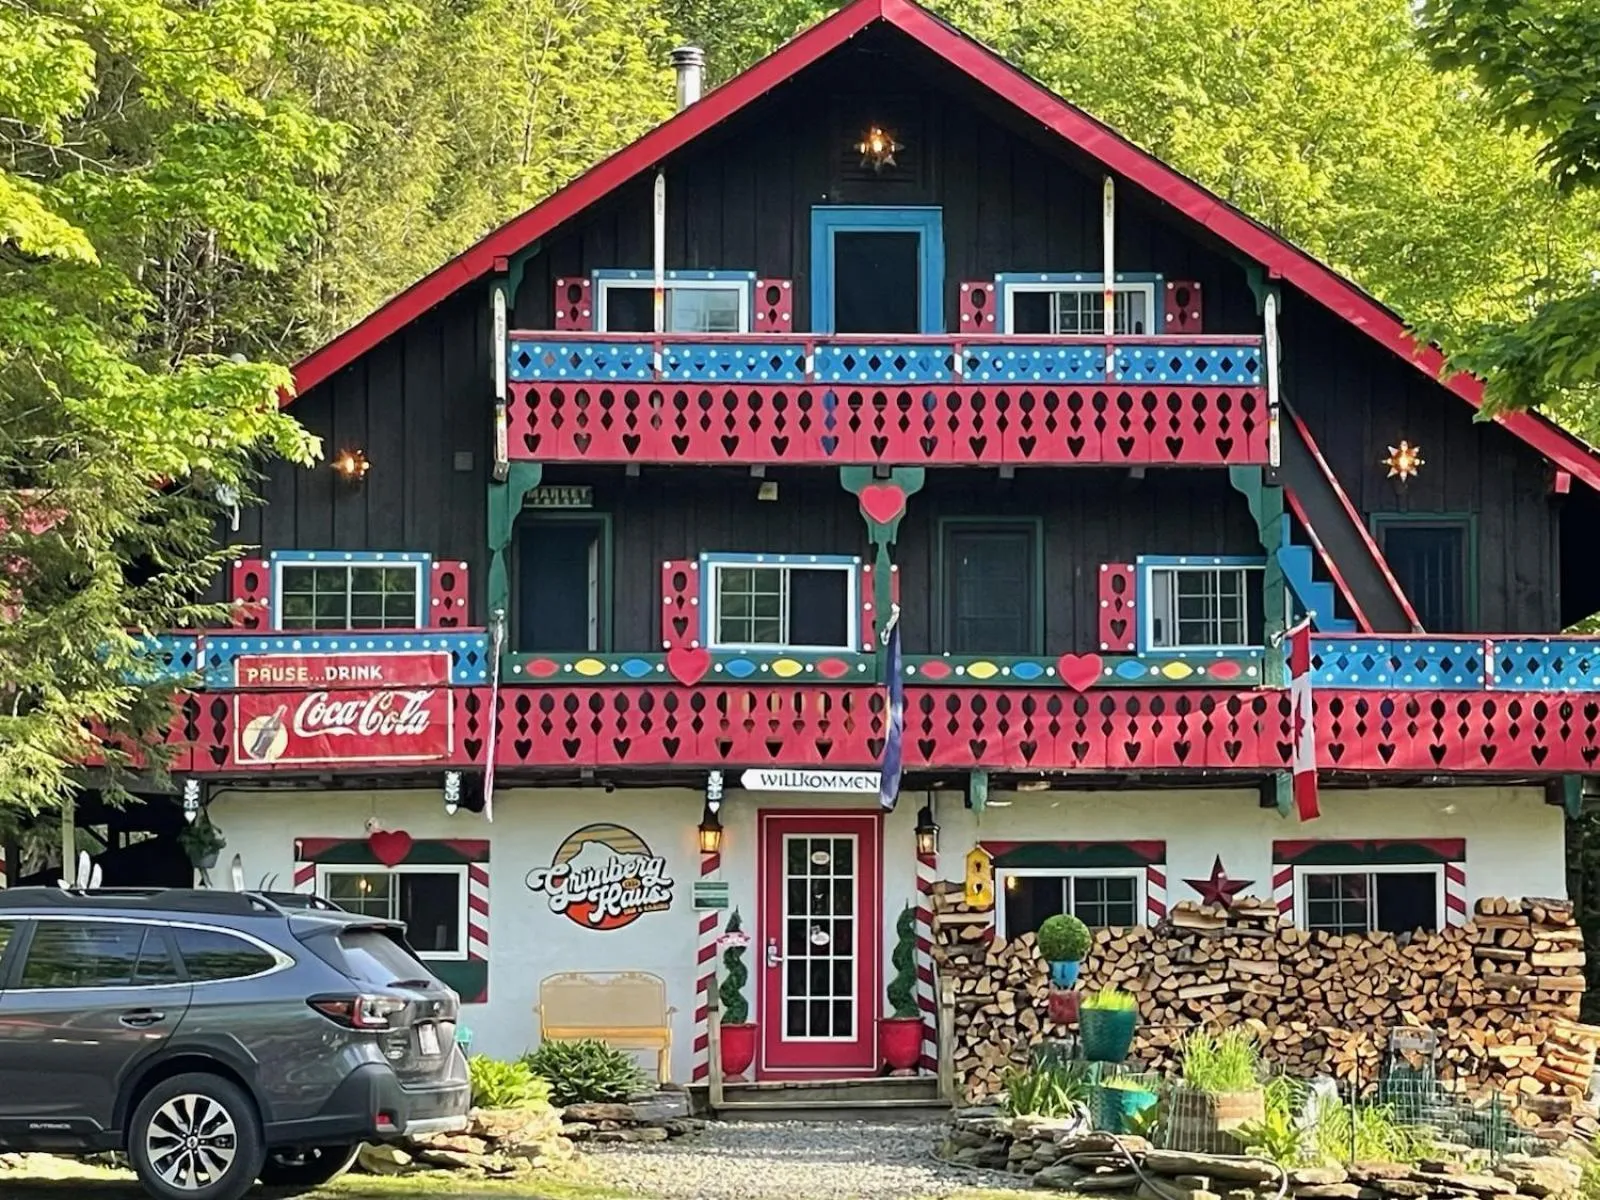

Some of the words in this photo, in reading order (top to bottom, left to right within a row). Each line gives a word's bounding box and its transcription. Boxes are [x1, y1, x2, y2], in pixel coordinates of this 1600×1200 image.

[294, 689, 434, 737] Coca-Cola
[760, 772, 878, 789] WILLKOMMEN
[525, 855, 674, 913] Grünberg
[587, 883, 673, 923] Haus
